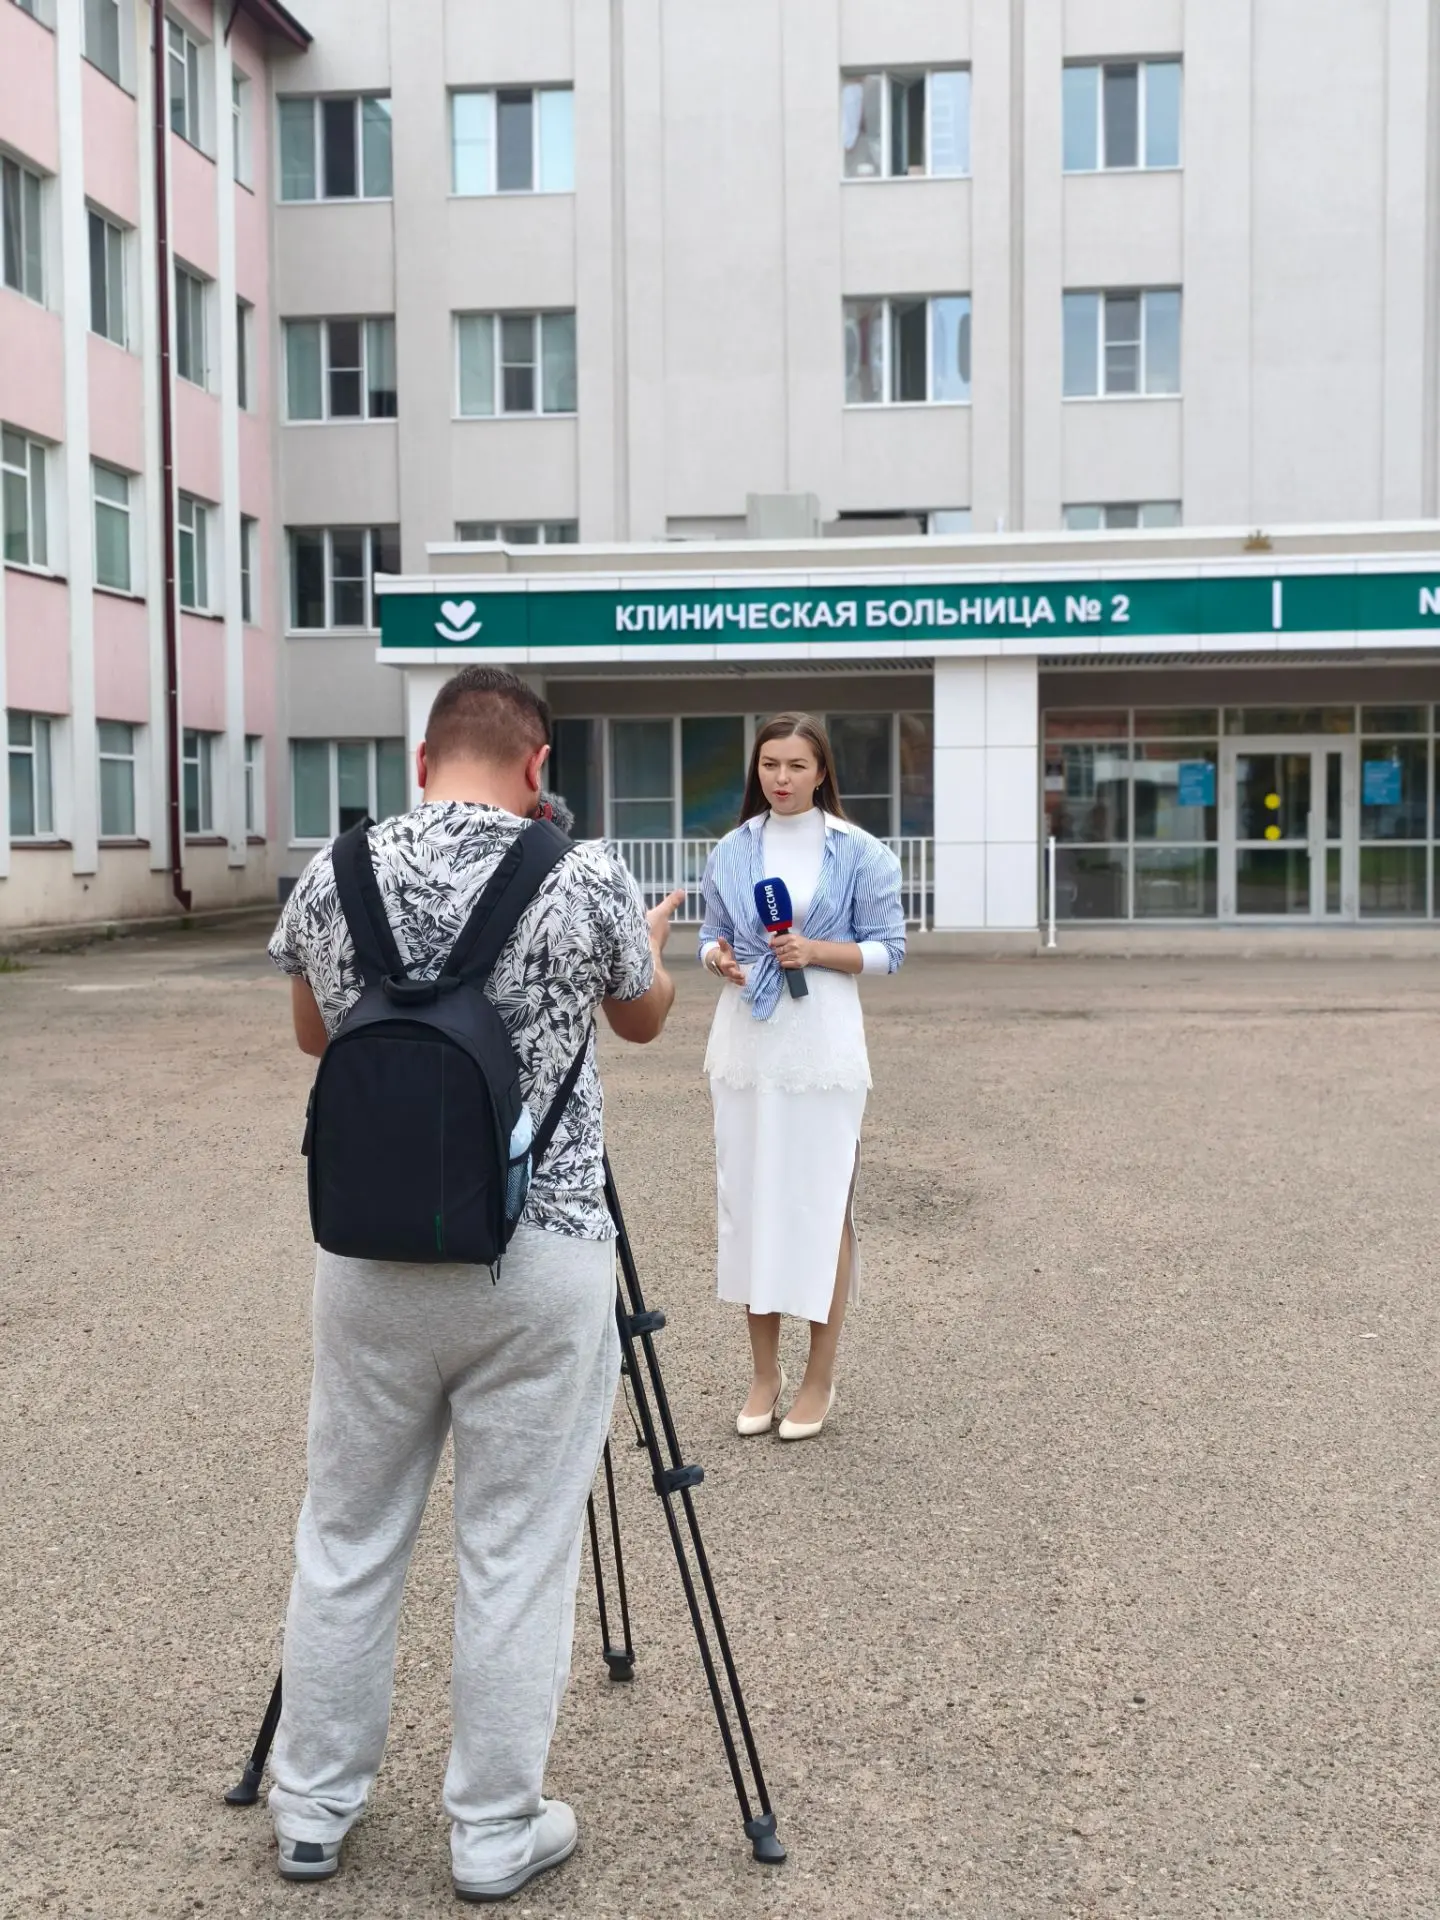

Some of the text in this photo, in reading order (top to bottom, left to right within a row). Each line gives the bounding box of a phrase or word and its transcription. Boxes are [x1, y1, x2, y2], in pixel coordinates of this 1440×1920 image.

[615, 594, 1130, 631] КЛИНИЧЕСКАЯ БОЛЬНИЦА № 2
[764, 884, 780, 922] РОССИЯ
